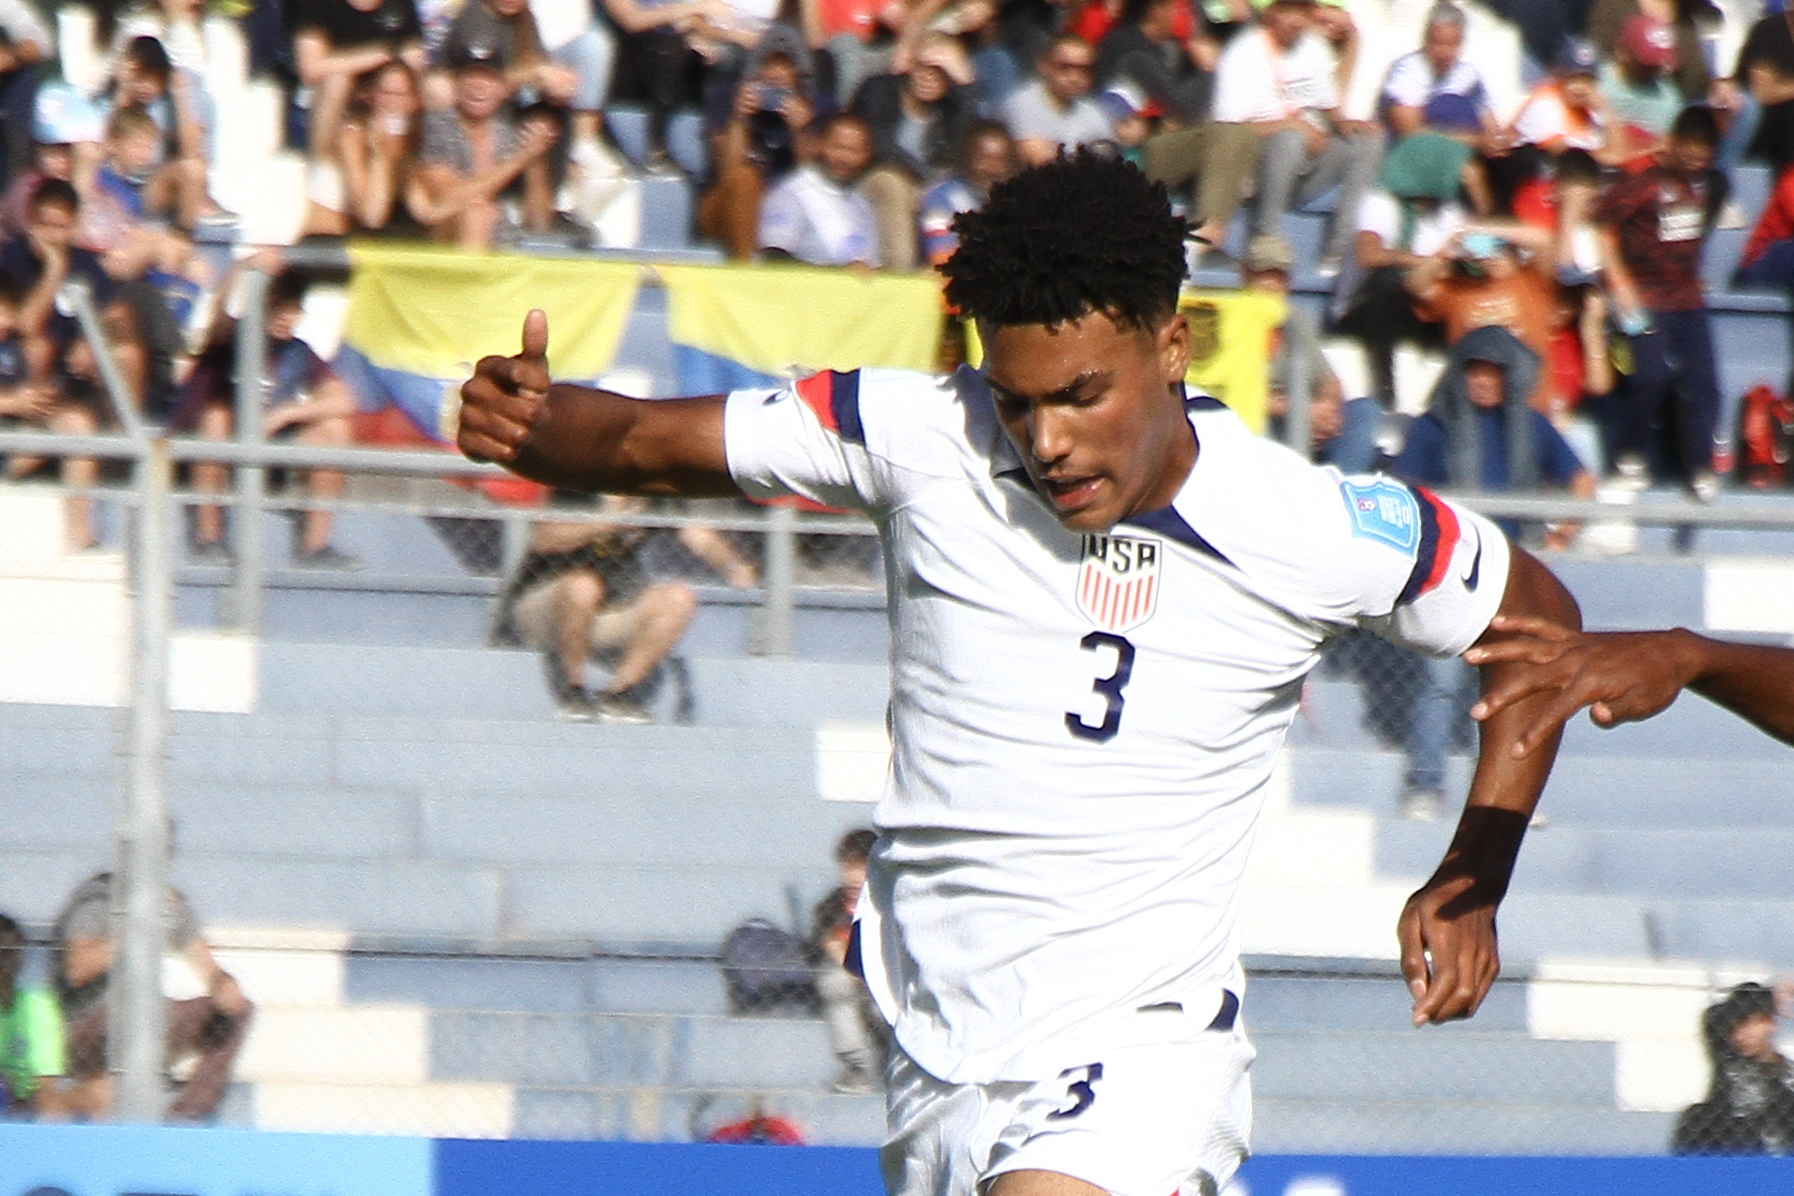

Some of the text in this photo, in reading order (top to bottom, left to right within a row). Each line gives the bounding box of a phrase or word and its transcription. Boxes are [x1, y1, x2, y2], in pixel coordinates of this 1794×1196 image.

[1085, 534, 1156, 574] USA
[1064, 630, 1136, 745] 3
[1044, 1061, 1104, 1123] 3
